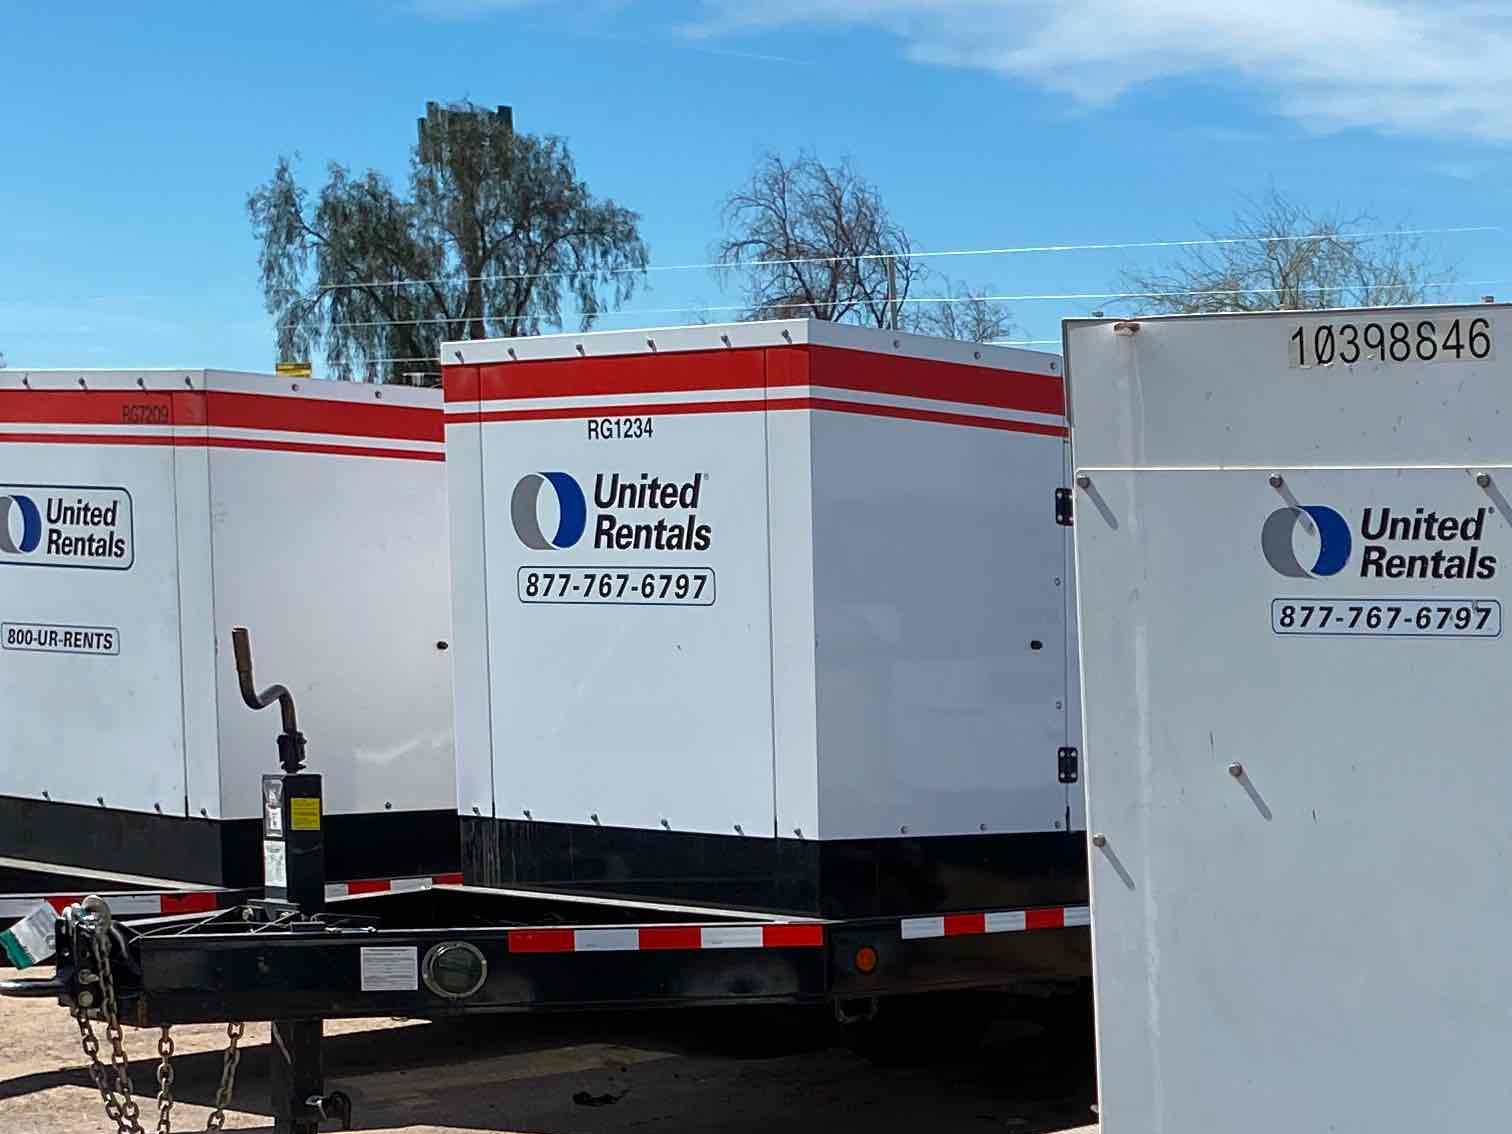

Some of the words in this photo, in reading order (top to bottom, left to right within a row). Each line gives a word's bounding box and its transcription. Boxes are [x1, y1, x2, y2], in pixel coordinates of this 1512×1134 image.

[1291, 318, 1491, 365] 10398846
[587, 417, 654, 440] RG1234
[594, 473, 702, 509] United
[47, 498, 118, 527] United
[1361, 507, 1485, 541] United
[47, 528, 126, 558] Rentals
[594, 514, 713, 551] Rentals
[1360, 545, 1497, 580] Rentals
[525, 573, 708, 599] 877-767-6797
[1279, 605, 1493, 630] 877-767-6797
[7, 628, 114, 650] 800-UR-RENTS
